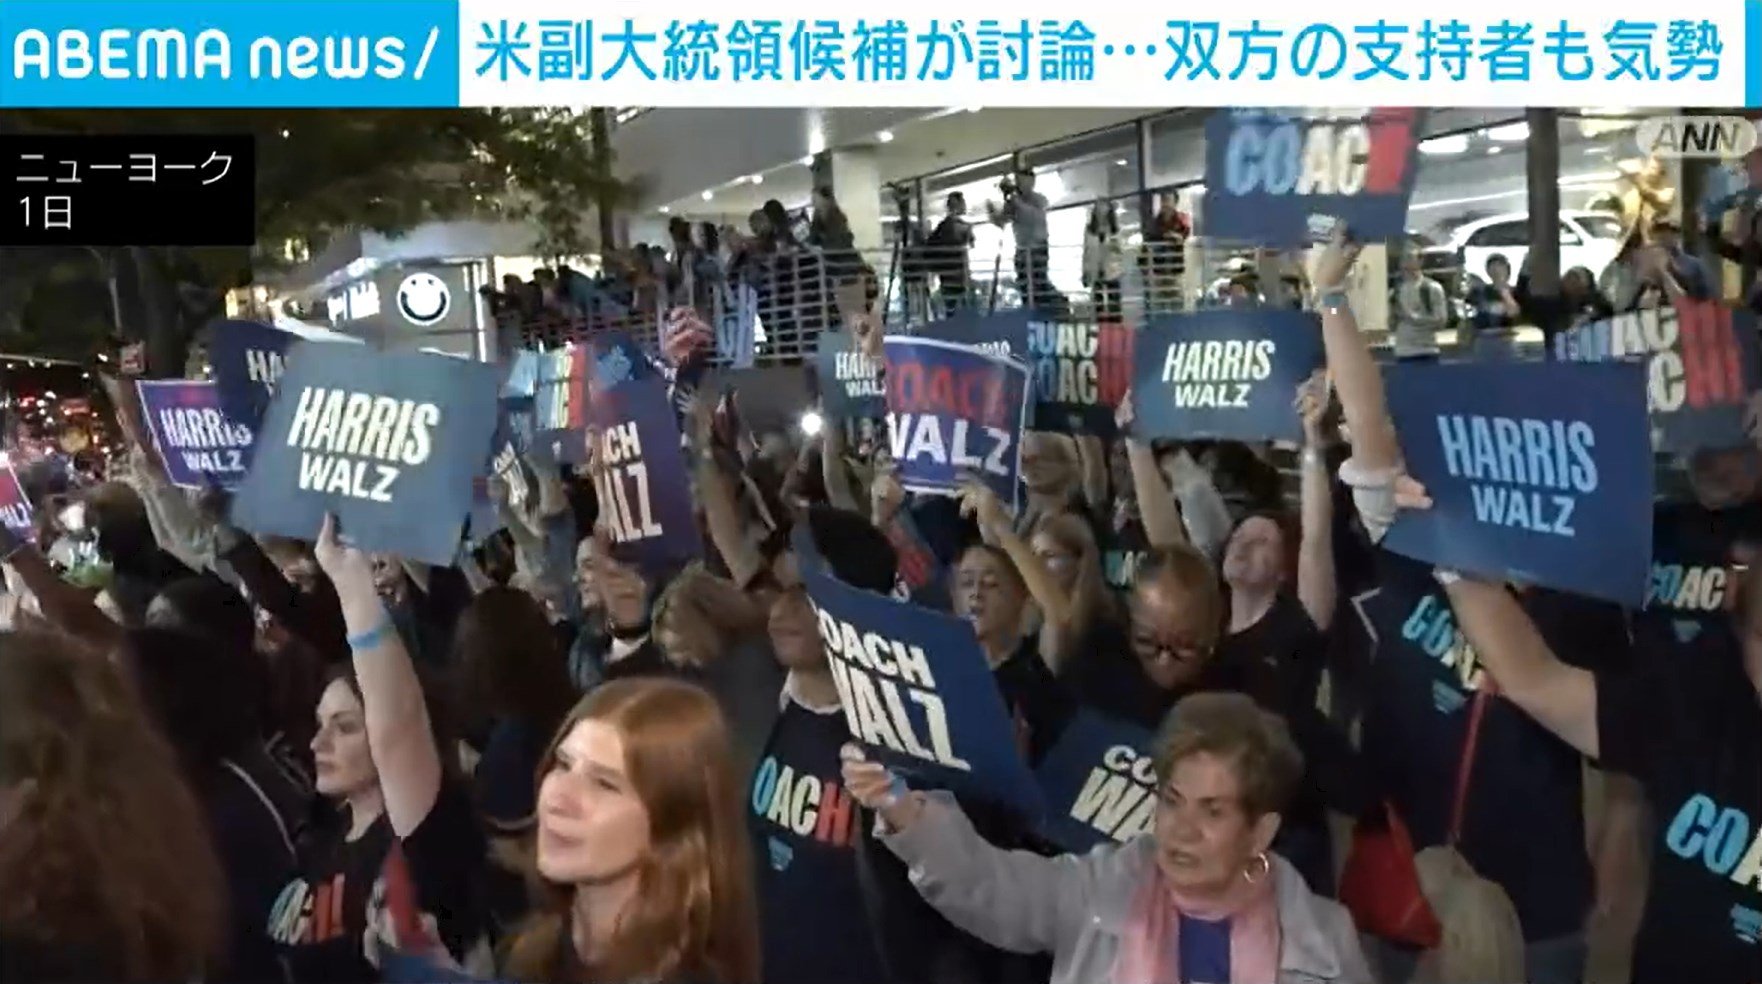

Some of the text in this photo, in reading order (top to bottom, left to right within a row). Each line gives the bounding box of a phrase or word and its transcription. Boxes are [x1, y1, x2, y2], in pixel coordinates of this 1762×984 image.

[1162, 339, 1275, 383] HARRIS
[1175, 383, 1251, 408] WALZ
[287, 385, 441, 466] HARRIS
[180, 448, 246, 472] WALZ
[298, 451, 400, 503] WALZ
[1437, 414, 1598, 493] HARRIS
[1470, 484, 1576, 537] WALZ
